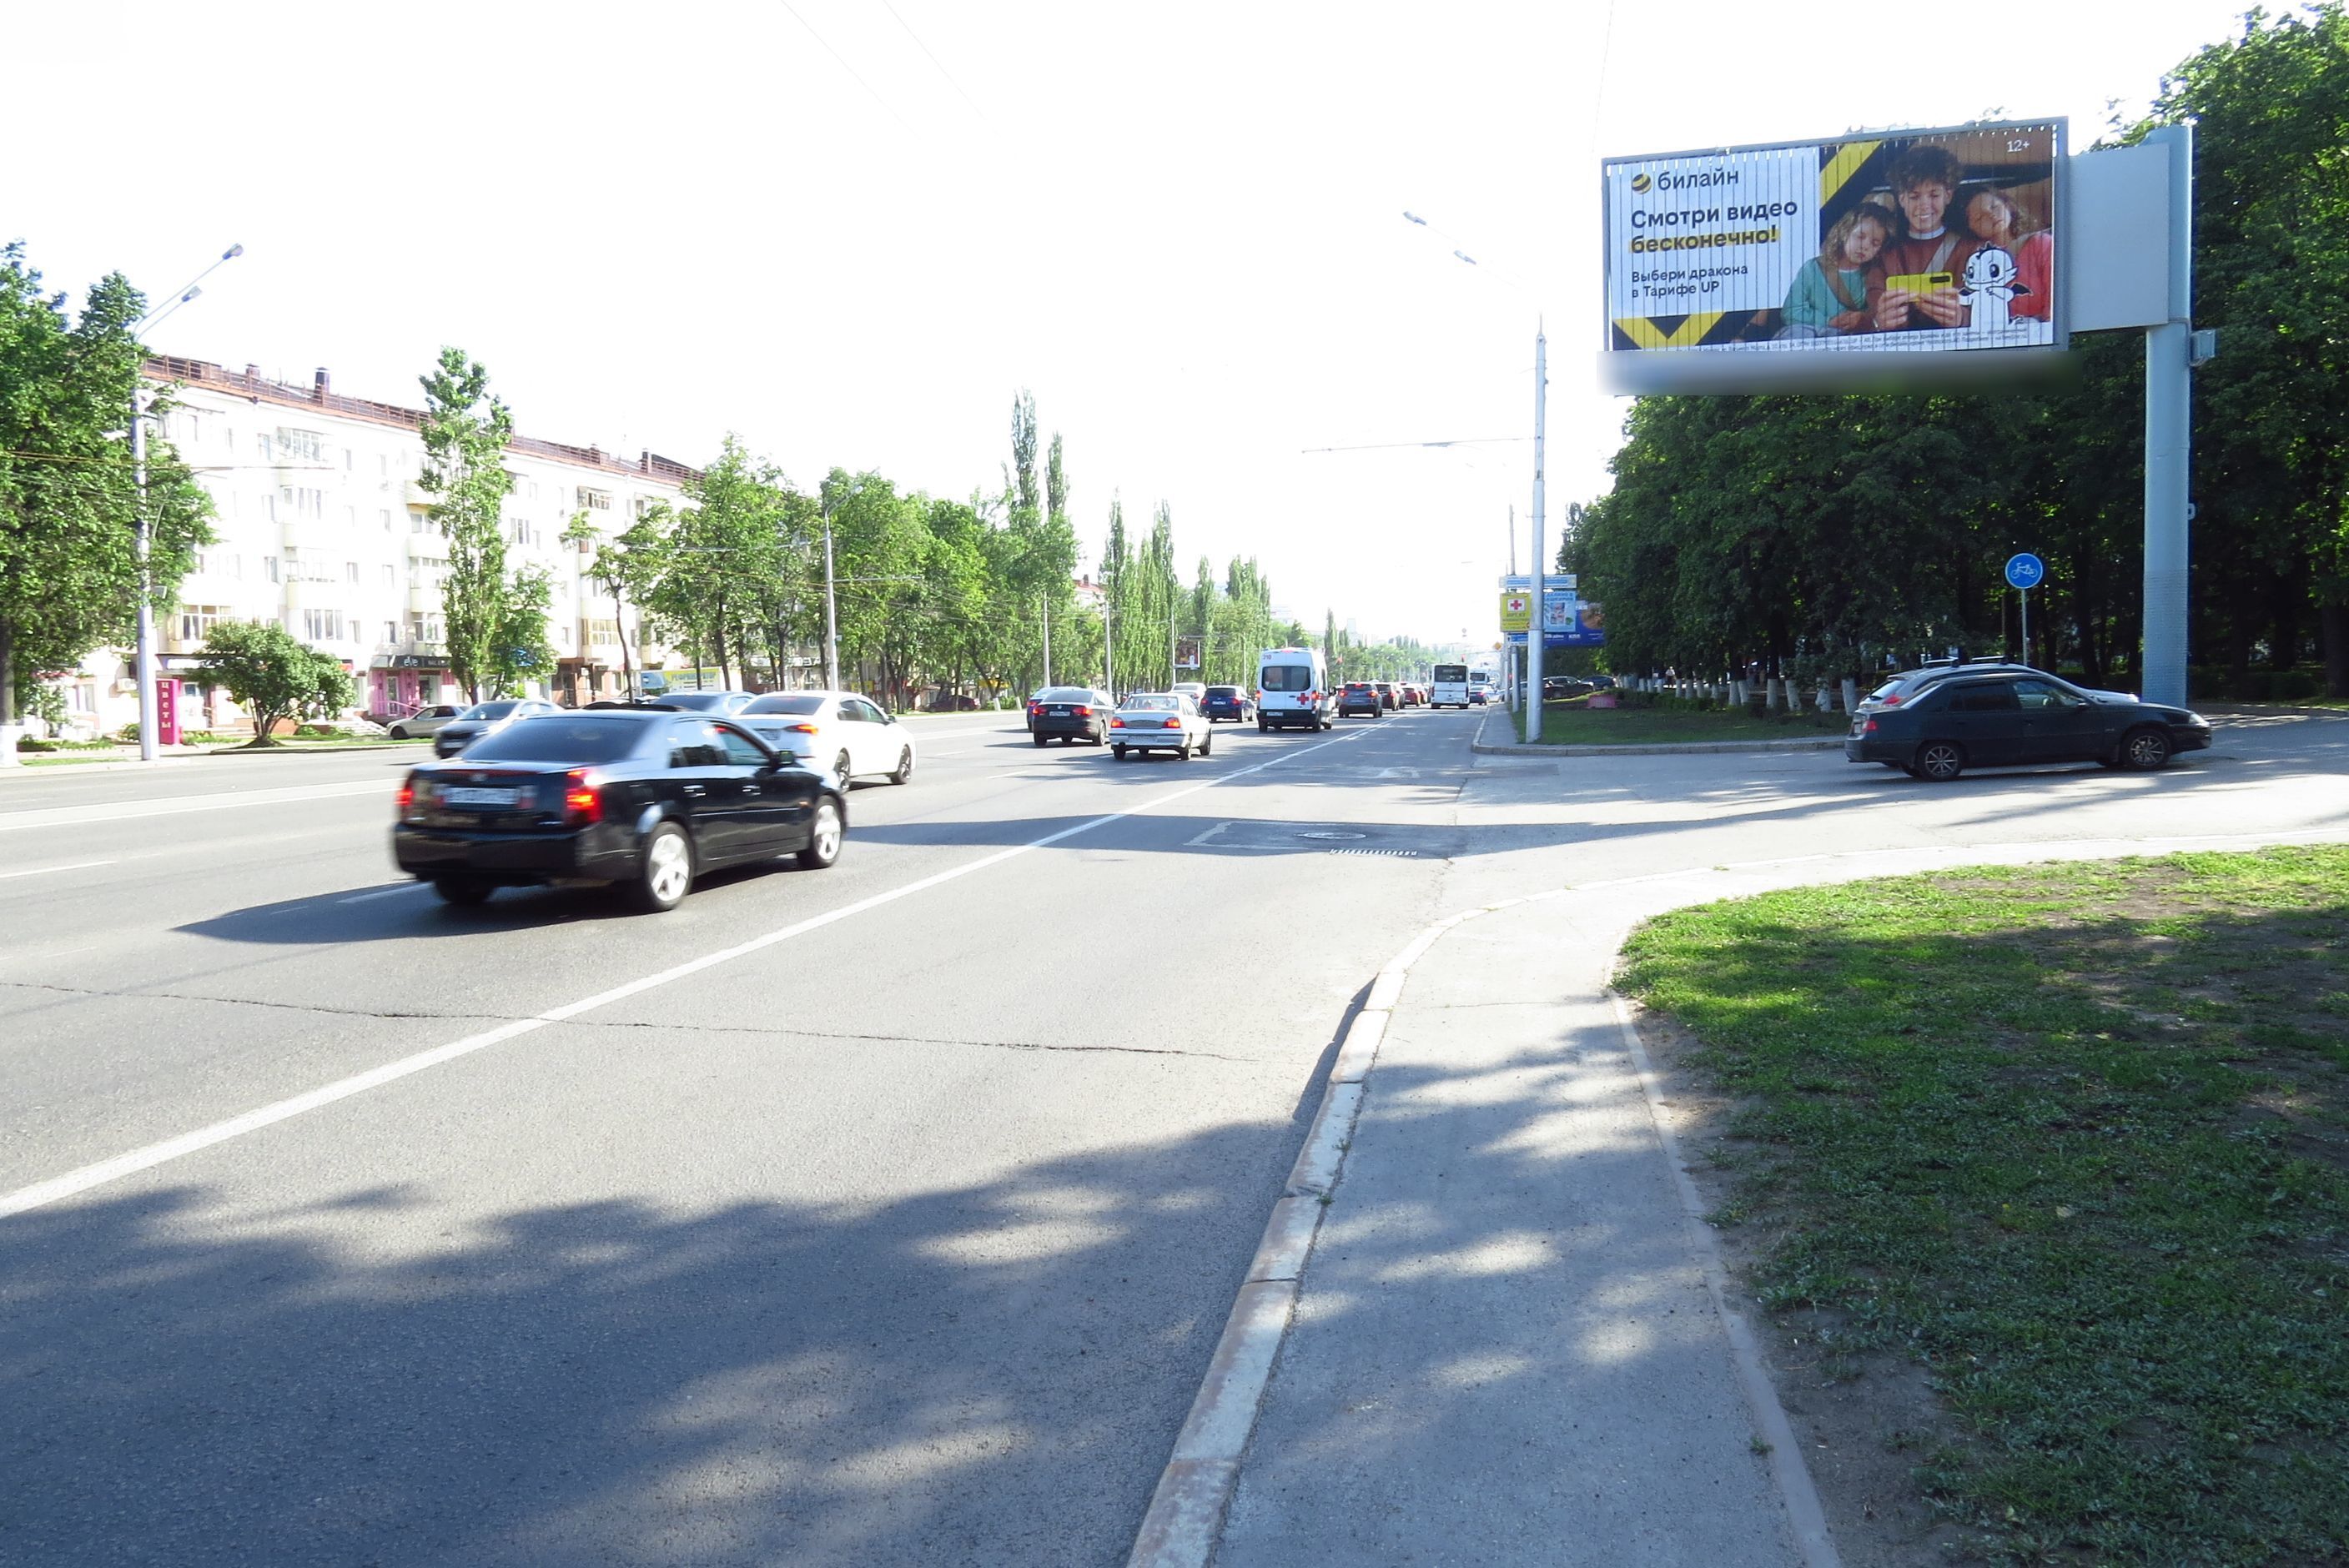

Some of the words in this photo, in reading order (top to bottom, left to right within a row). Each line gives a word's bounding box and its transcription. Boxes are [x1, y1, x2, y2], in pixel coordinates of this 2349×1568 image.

[2006, 139, 2030, 153] 12+
[1657, 167, 1739, 191] билайн
[1631, 208, 1719, 229] Смотри
[1727, 200, 1798, 222] видео
[1631, 224, 1777, 254] бесконечно!
[1632, 269, 1686, 283] Выбери
[1688, 264, 1748, 280] дракона
[1632, 289, 1639, 299] в
[1643, 283, 1697, 299] Тарифе
[1701, 280, 1719, 293] UP
